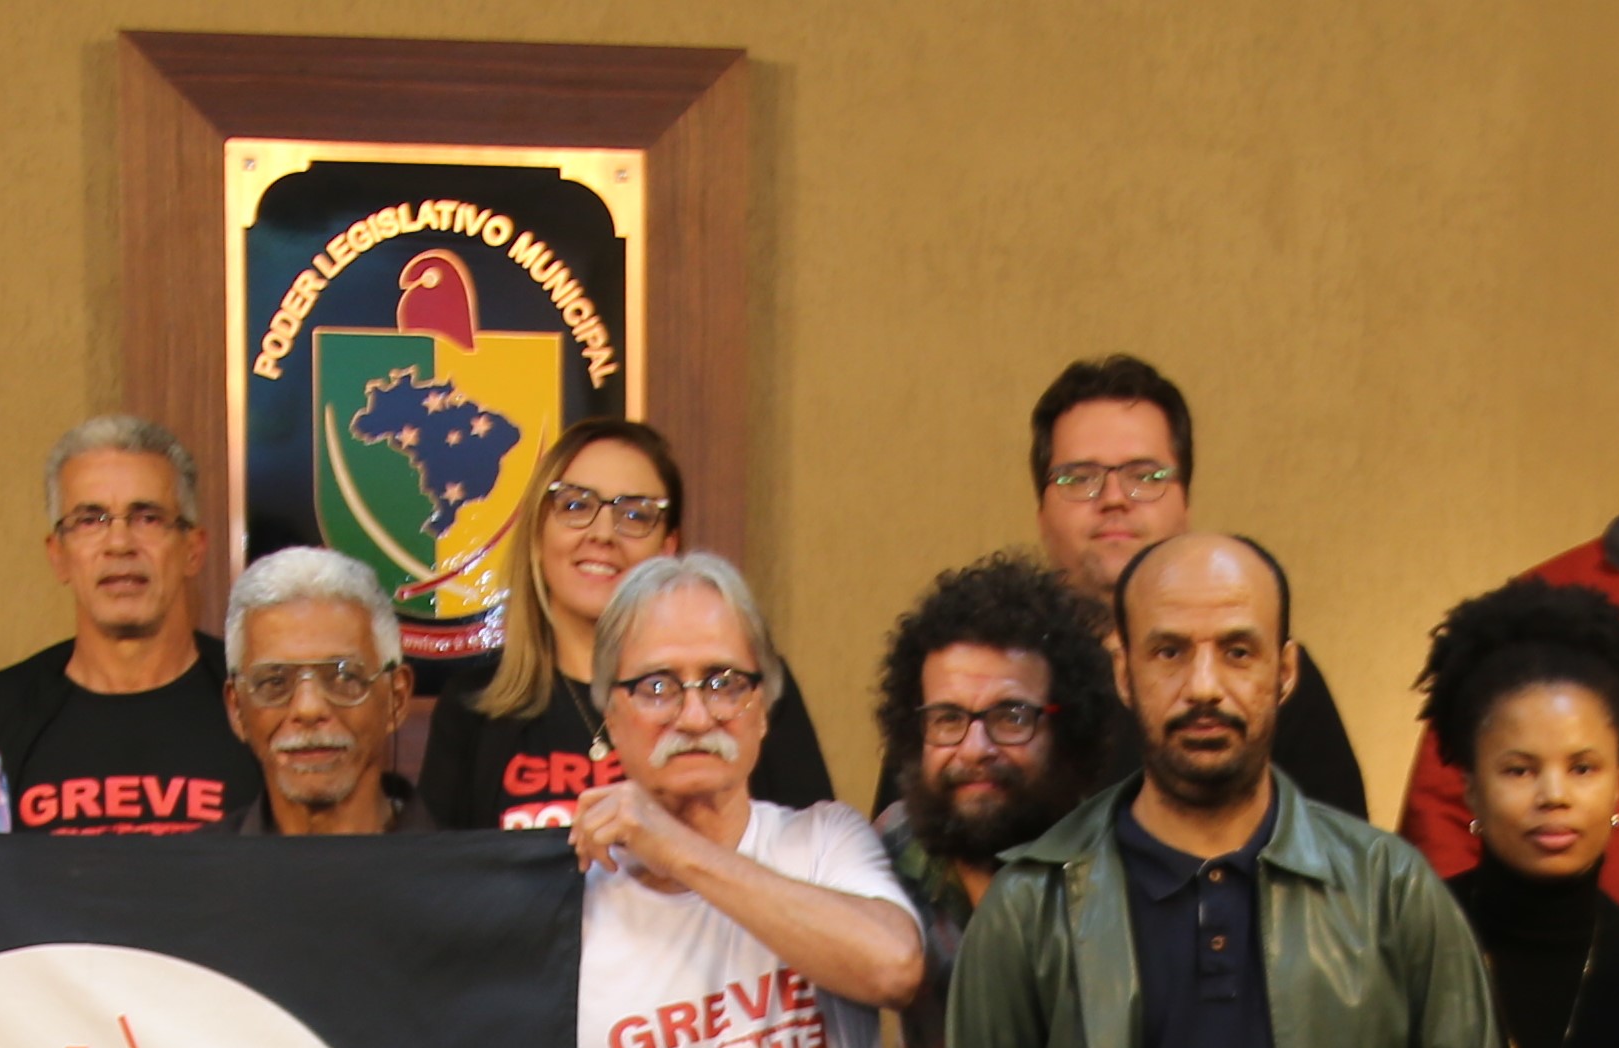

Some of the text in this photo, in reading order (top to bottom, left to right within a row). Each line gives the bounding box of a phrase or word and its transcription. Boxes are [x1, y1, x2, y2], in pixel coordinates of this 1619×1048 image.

[253, 200, 620, 389] PODER LEGISLATIVO MUNICIPAL
[502, 750, 628, 797] GRE
[19, 776, 226, 827] GREVE
